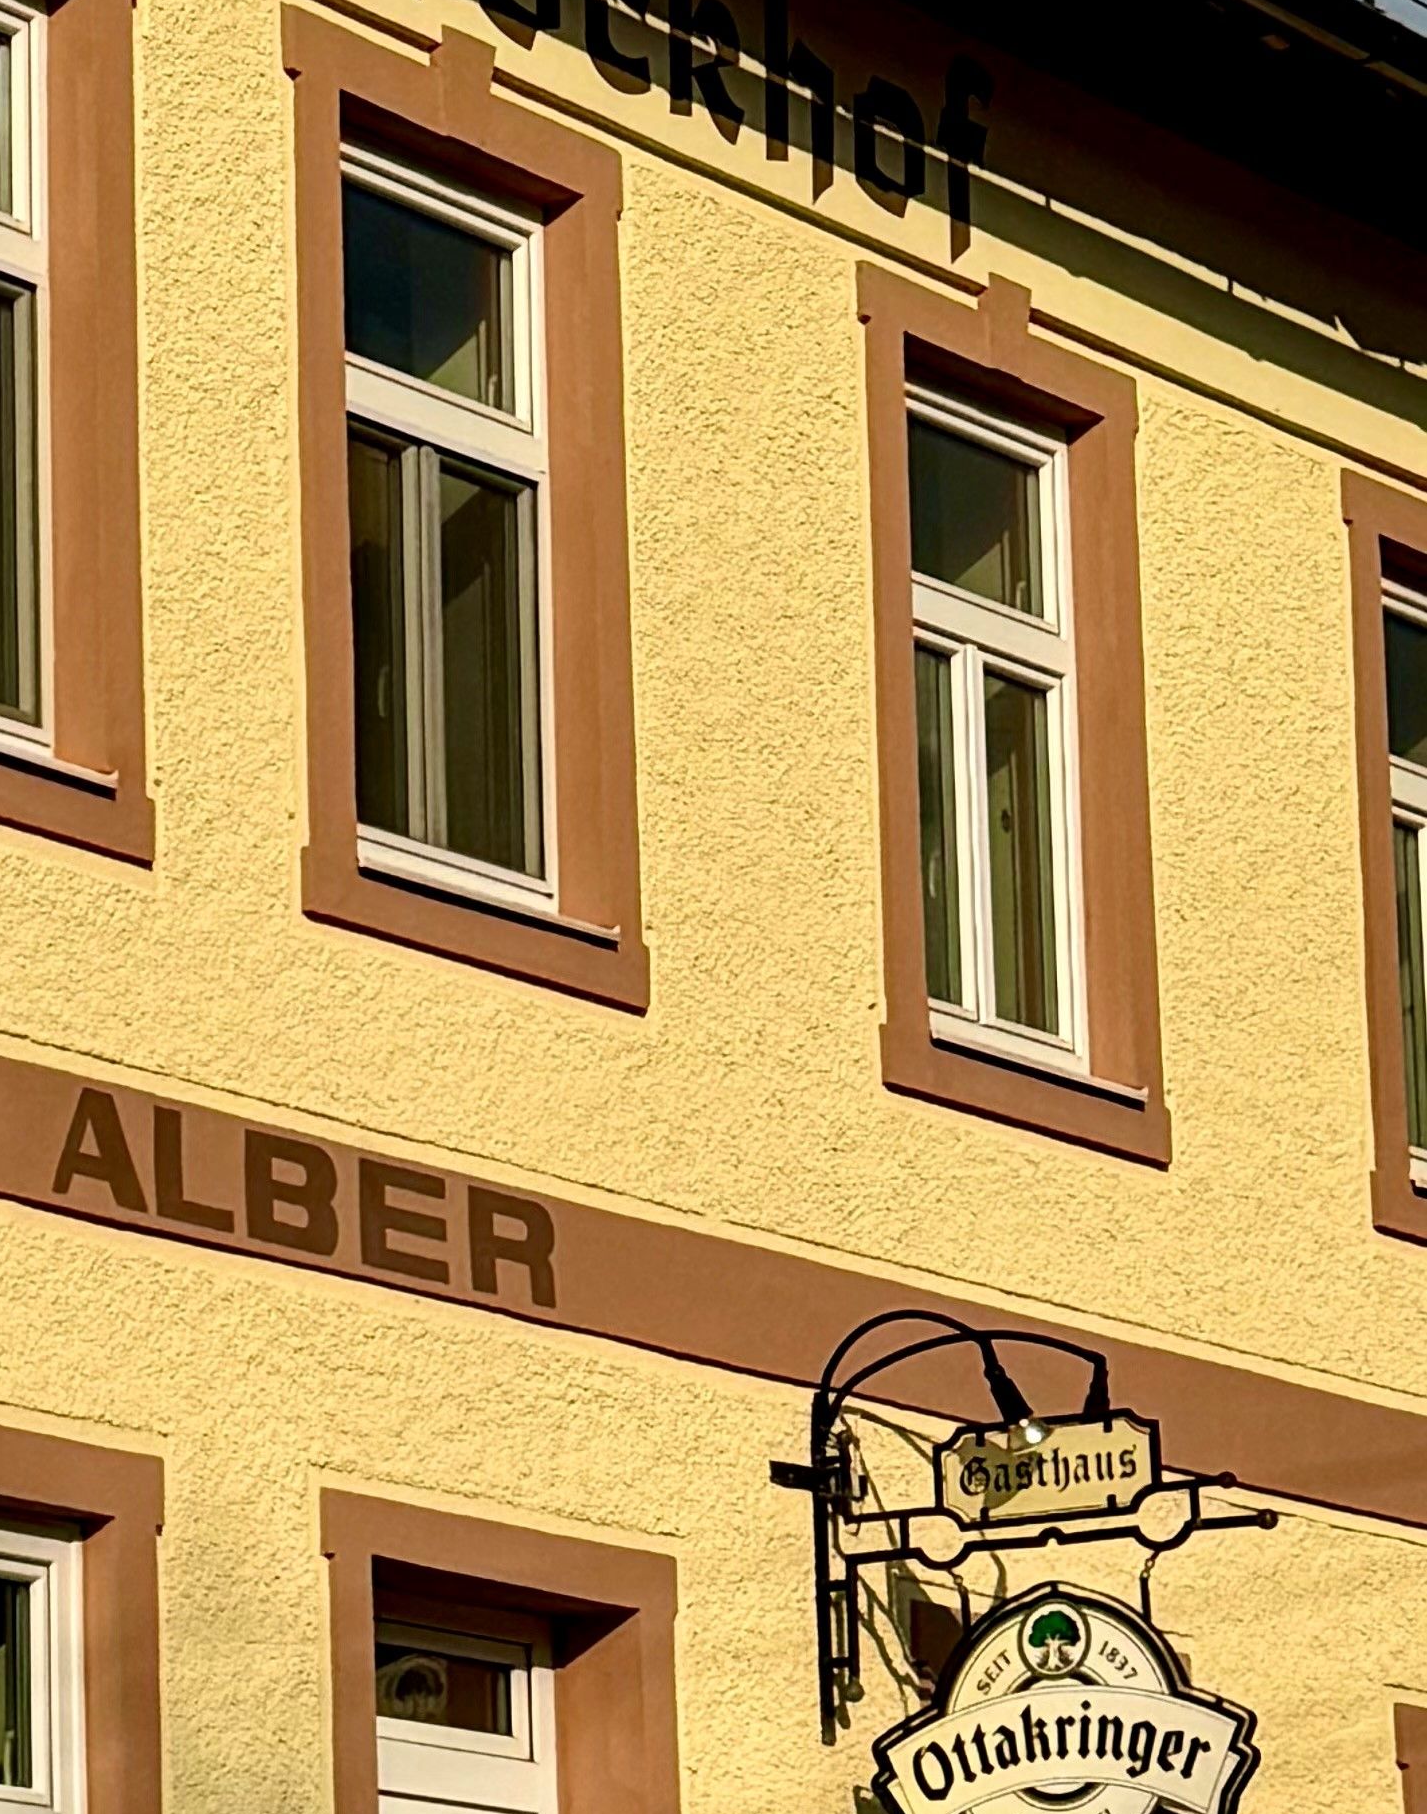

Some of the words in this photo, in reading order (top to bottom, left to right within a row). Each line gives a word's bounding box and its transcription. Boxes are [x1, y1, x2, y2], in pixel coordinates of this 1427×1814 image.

[51, 1087, 557, 1309] ALBER
[958, 1443, 1138, 1497] Gasthaus
[977, 1649, 1012, 1696] SEIT
[1098, 1640, 1139, 1681] 1837
[912, 1699, 1212, 1801] Ottakringer
